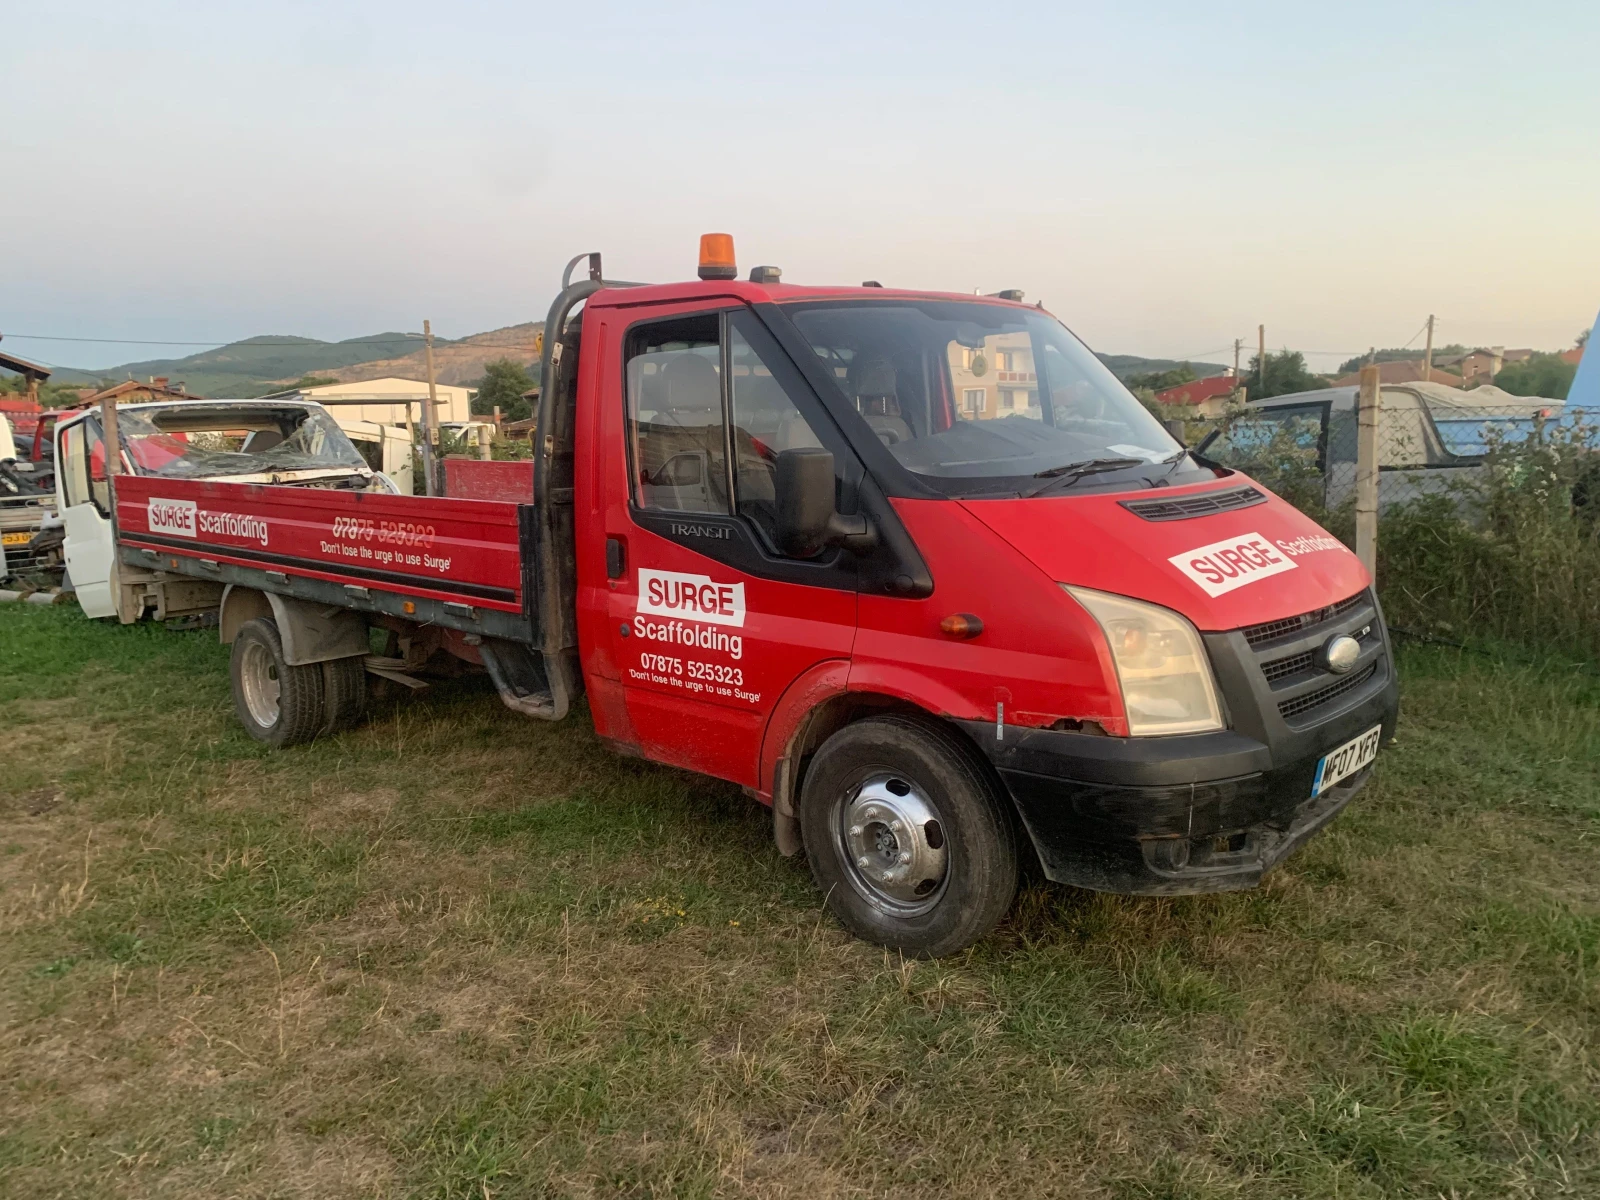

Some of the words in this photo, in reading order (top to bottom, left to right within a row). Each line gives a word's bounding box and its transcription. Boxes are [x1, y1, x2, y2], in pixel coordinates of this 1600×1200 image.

[152, 504, 192, 530] SURGE
[199, 510, 268, 546] Scaffolding
[332, 516, 374, 541] 07875
[377, 521, 435, 548] 525323
[670, 524, 732, 539] TRANSIT
[342, 543, 358, 557] lose
[360, 546, 372, 558] the
[374, 550, 393, 564] urge
[395, 551, 403, 563] to
[406, 554, 421, 566] use
[1189, 540, 1283, 584] SURGE
[648, 578, 735, 617] SURGE
[634, 616, 743, 660] Scaffolding
[640, 652, 683, 675] 07875
[687, 660, 744, 686] 525323
[651, 673, 668, 684] lose
[669, 677, 682, 687] the
[685, 681, 703, 692] urge
[705, 684, 714, 693] to
[717, 687, 732, 696] use
